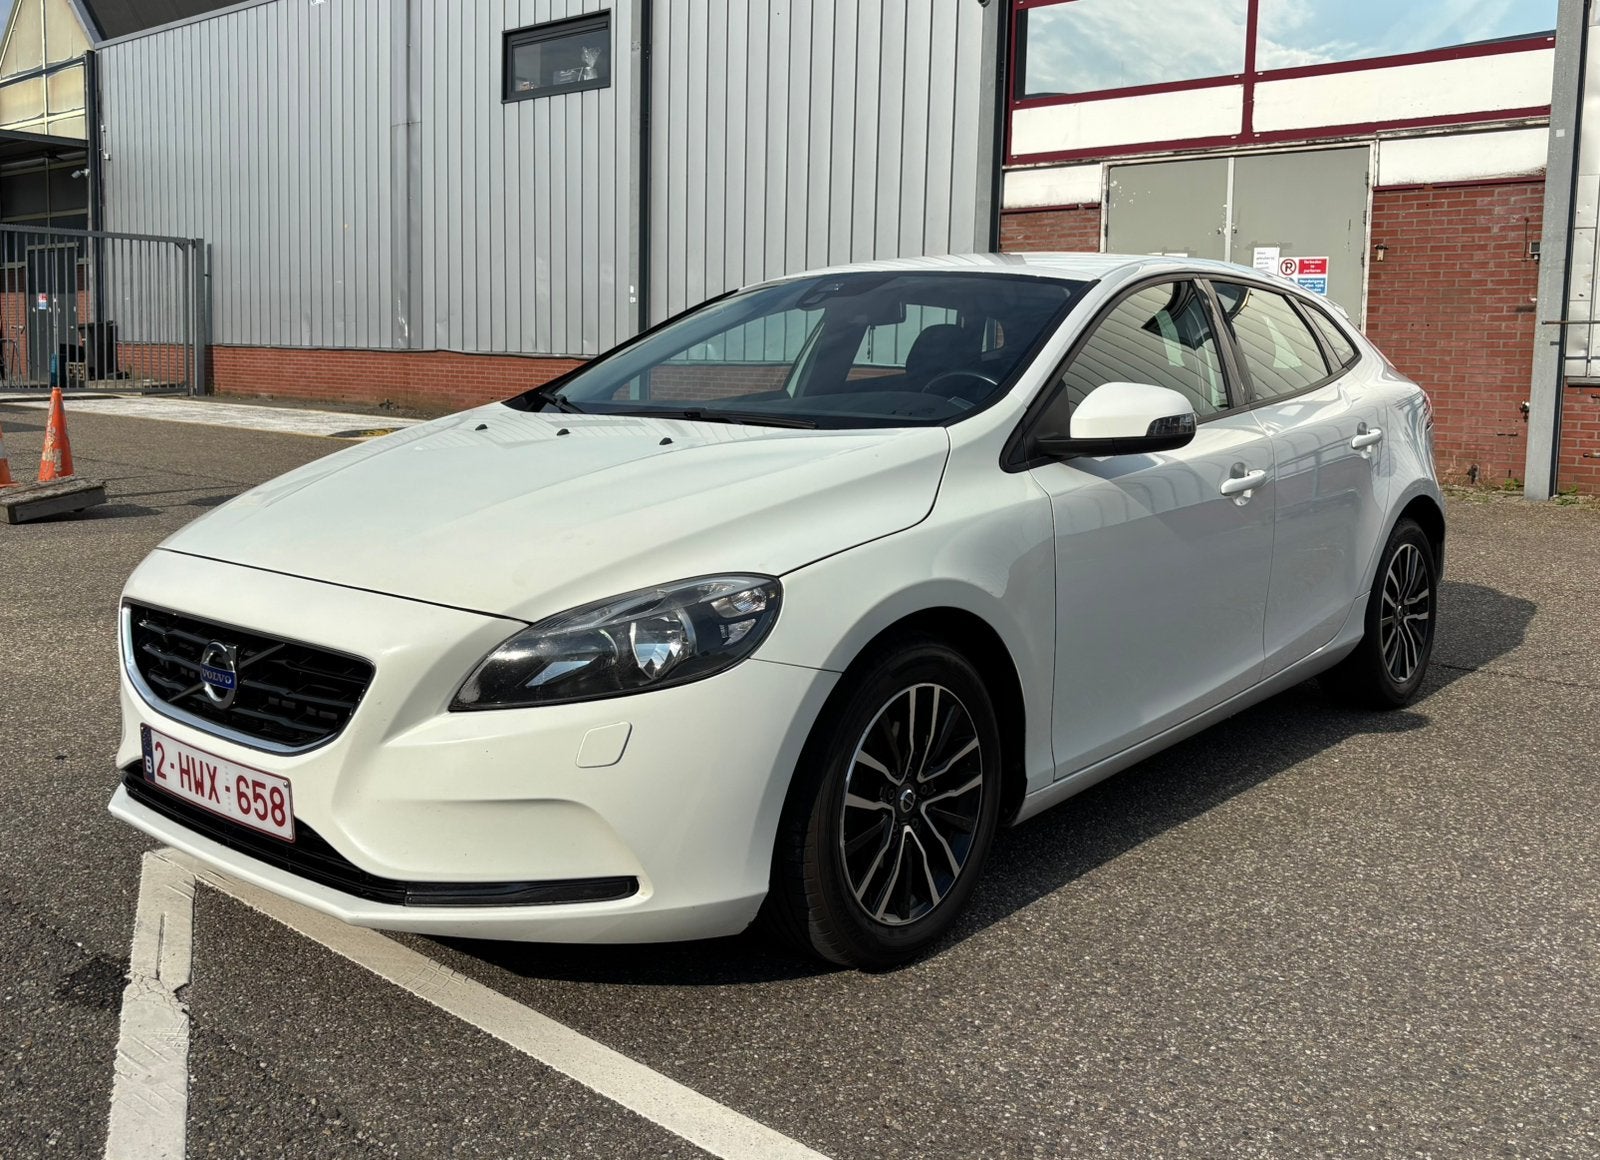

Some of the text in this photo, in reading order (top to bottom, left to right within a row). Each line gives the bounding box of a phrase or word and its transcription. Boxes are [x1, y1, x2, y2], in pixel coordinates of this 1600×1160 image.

[202, 668, 232, 685] VOLVO
[145, 756, 153, 774] B
[155, 741, 286, 828] 2-HWX-658
